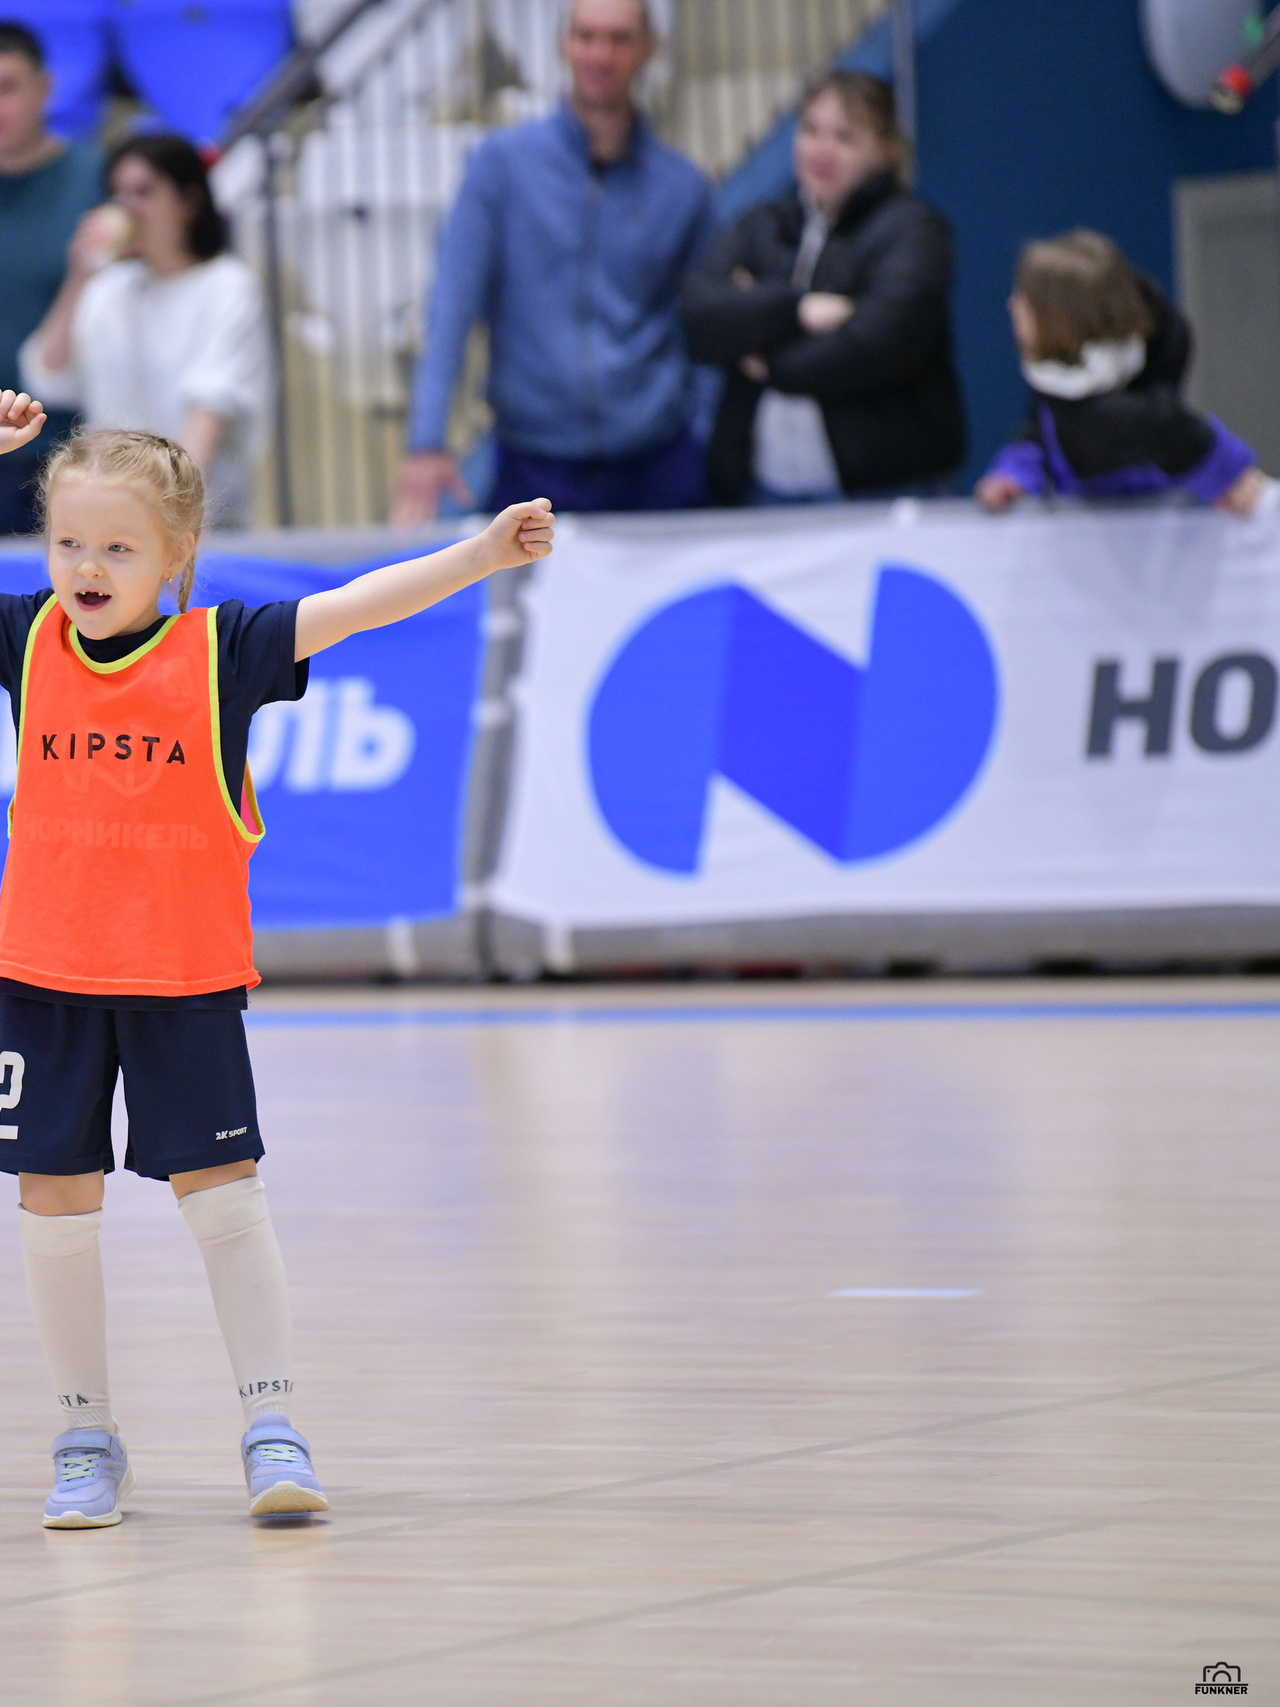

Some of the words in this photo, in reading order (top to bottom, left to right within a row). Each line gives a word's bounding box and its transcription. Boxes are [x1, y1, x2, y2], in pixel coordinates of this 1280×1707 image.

[1083, 653, 1279, 759] НО
[41, 732, 186, 765] KIPSTA
[22, 813, 209, 851] НОРНИКЕЛЬ
[228, 1126, 248, 1138] SPORT
